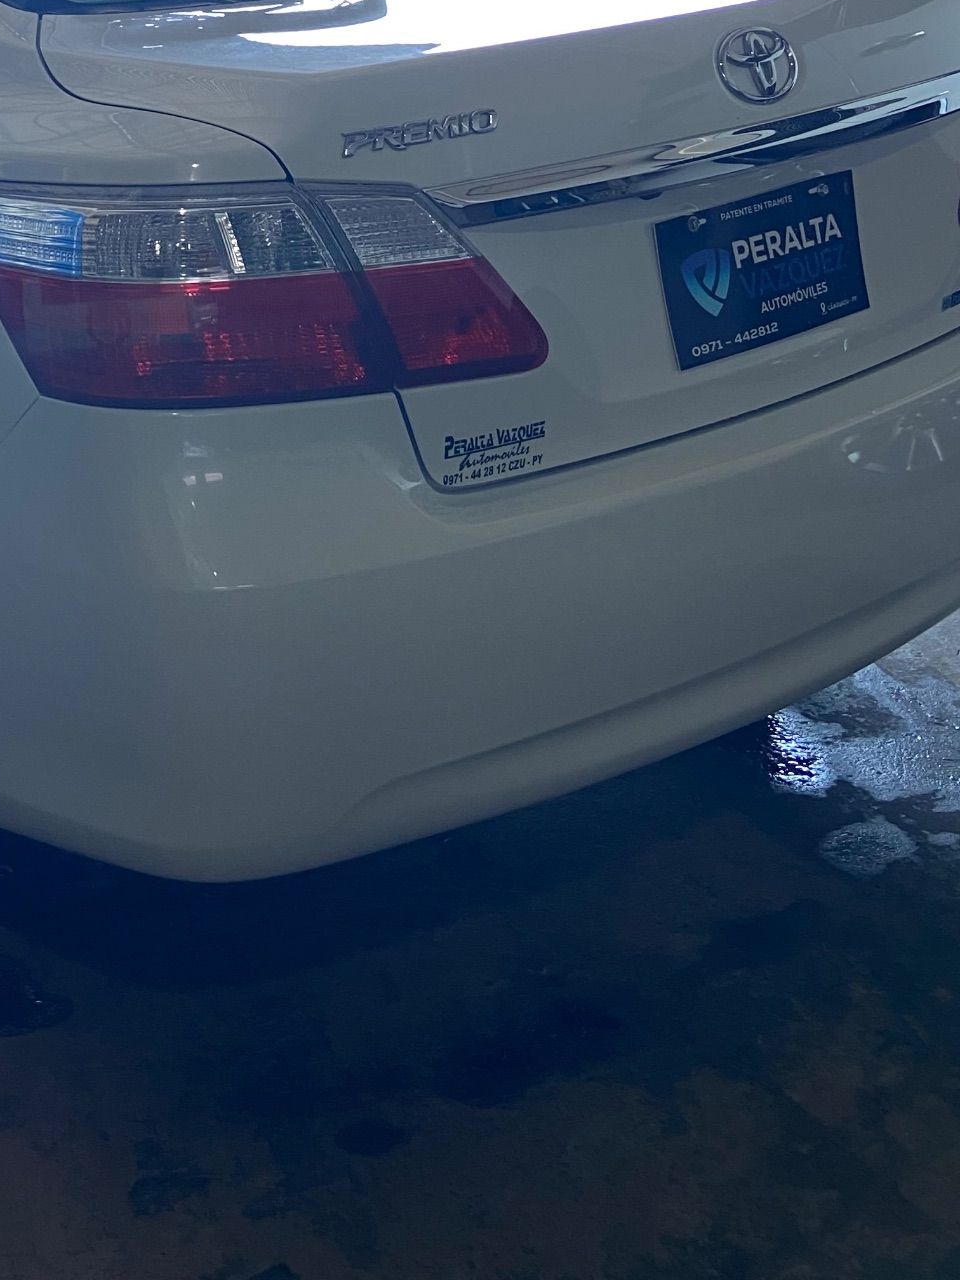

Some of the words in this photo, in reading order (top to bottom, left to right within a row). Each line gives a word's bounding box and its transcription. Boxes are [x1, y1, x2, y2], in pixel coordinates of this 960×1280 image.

[341, 108, 498, 159] PREMIO
[720, 206, 753, 221] PATENTE
[753, 202, 763, 214] EN
[763, 194, 793, 211] TRAMITE
[731, 213, 842, 269] PERALTA
[738, 244, 848, 299] VAZQUEZ
[760, 281, 828, 314] AUTOMÓVILES
[691, 339, 724, 358] 0971
[734, 321, 779, 345] 442812
[444, 432, 494, 459] PERALTA
[496, 420, 546, 445] VAZQUEZ
[443, 473, 463, 486] 0971
[471, 468, 482, 480] 44
[484, 465, 494, 477] 28
[496, 463, 506, 474] 12
[508, 458, 525, 471] CZU
[532, 454, 543, 466] PY
